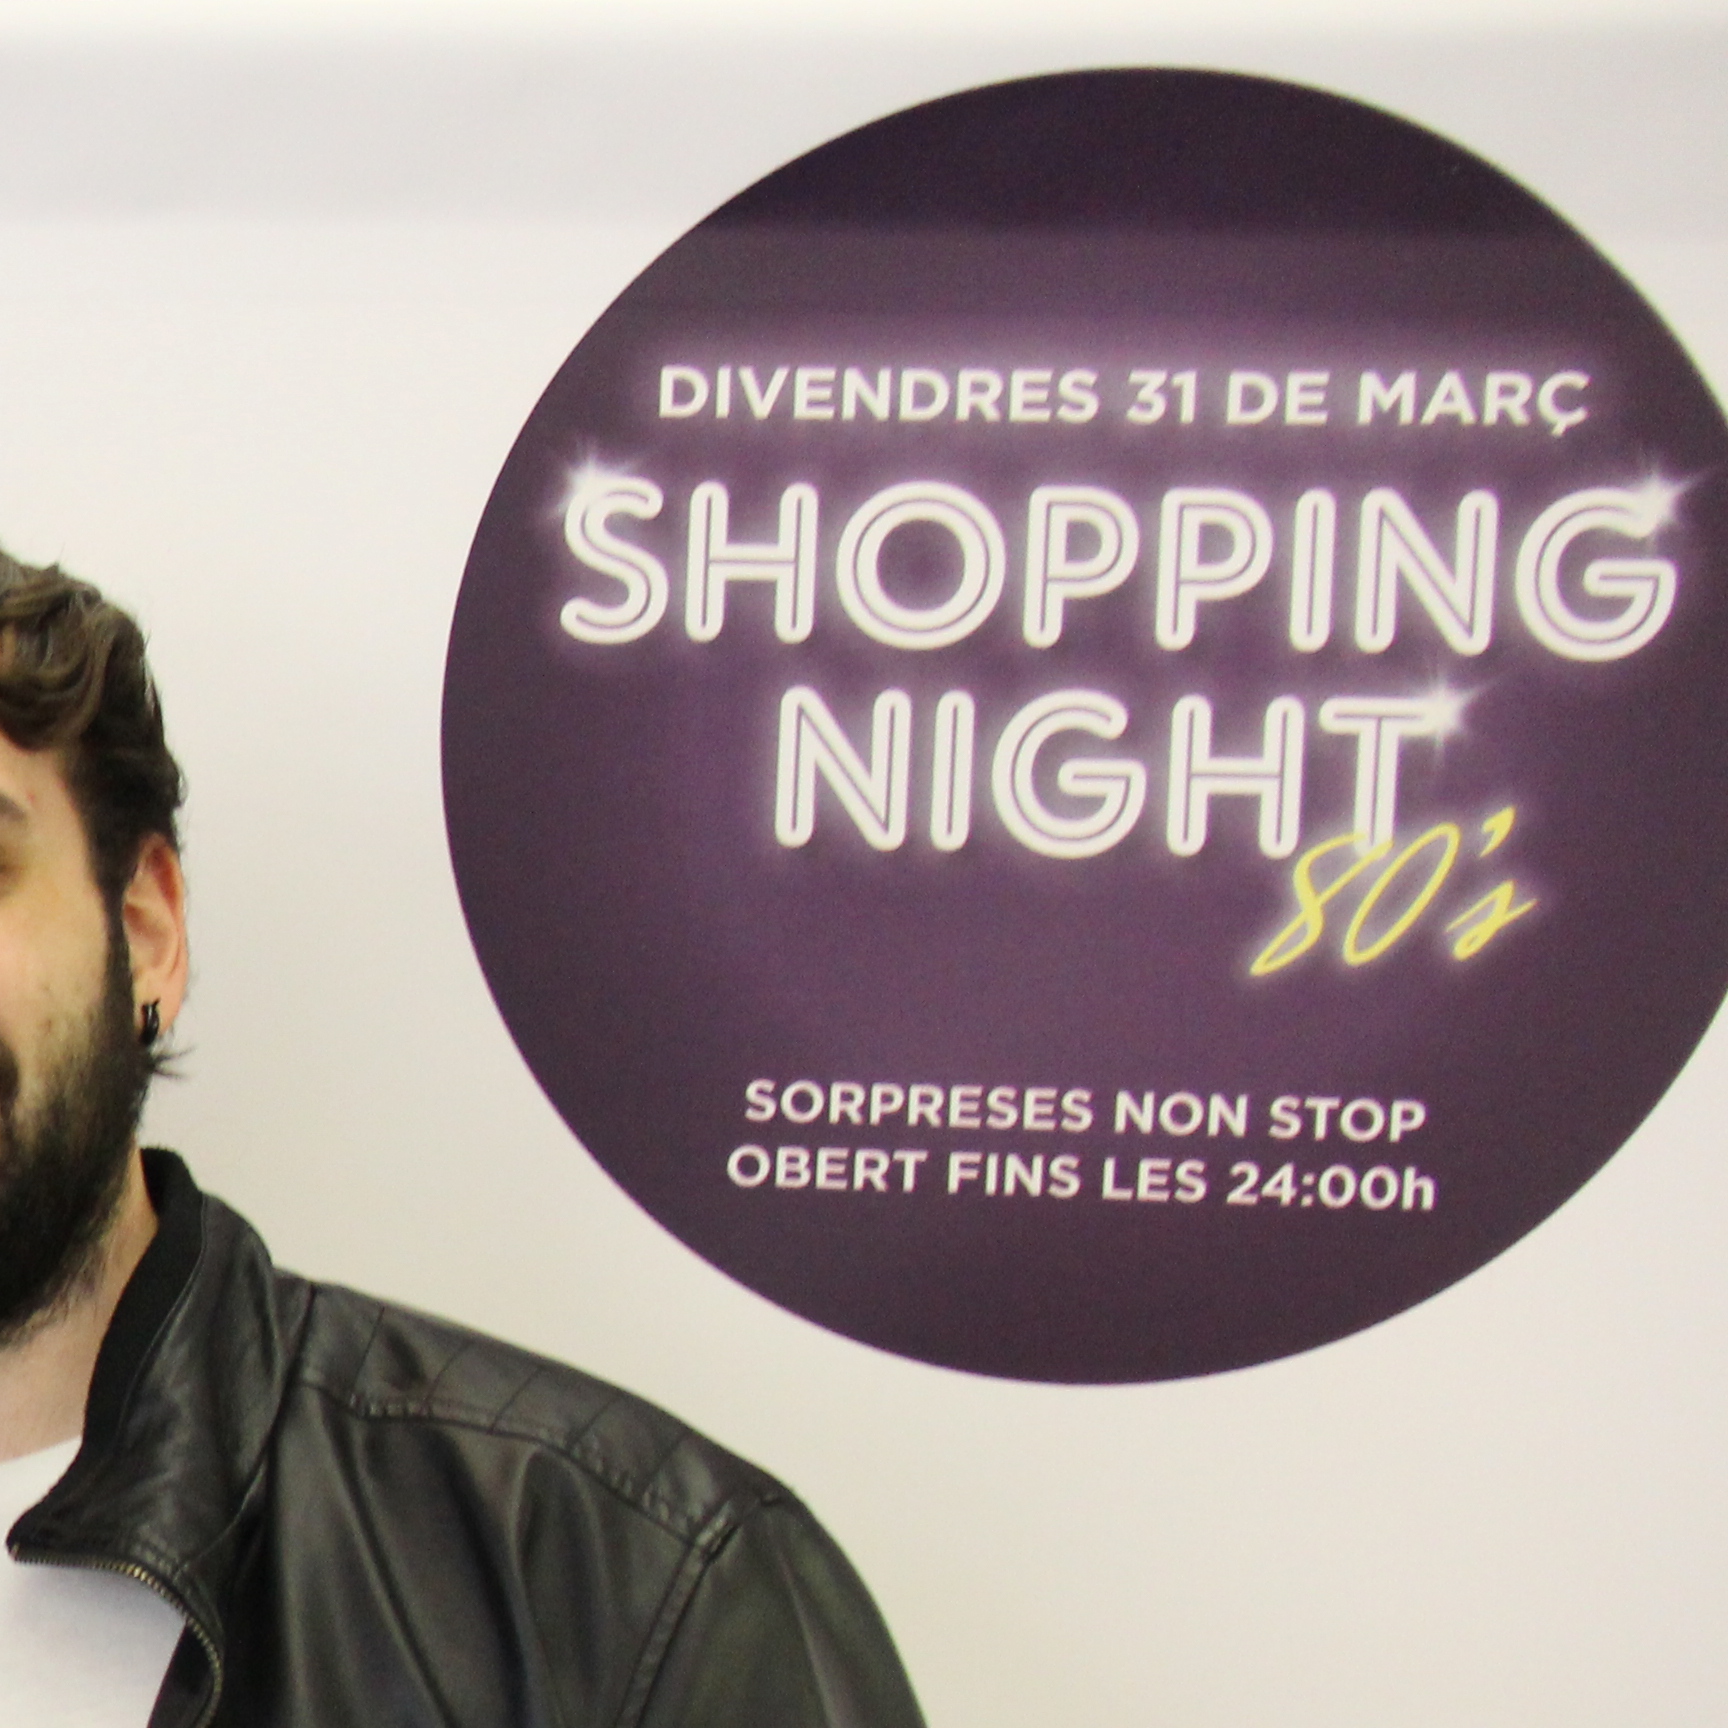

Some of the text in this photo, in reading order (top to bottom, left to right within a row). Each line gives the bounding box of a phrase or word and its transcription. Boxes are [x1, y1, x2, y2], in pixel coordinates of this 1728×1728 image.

[659, 366, 1591, 438] DIVENDRES 31 DE MARÇ
[559, 477, 1678, 663] SHOPPING
[775, 685, 1456, 859] NIGHT
[1249, 807, 1539, 978] 80's
[744, 1078, 1427, 1144] SORPRESES NON STOP
[726, 1144, 1436, 1212] OBERT FINS LES 24:00h
